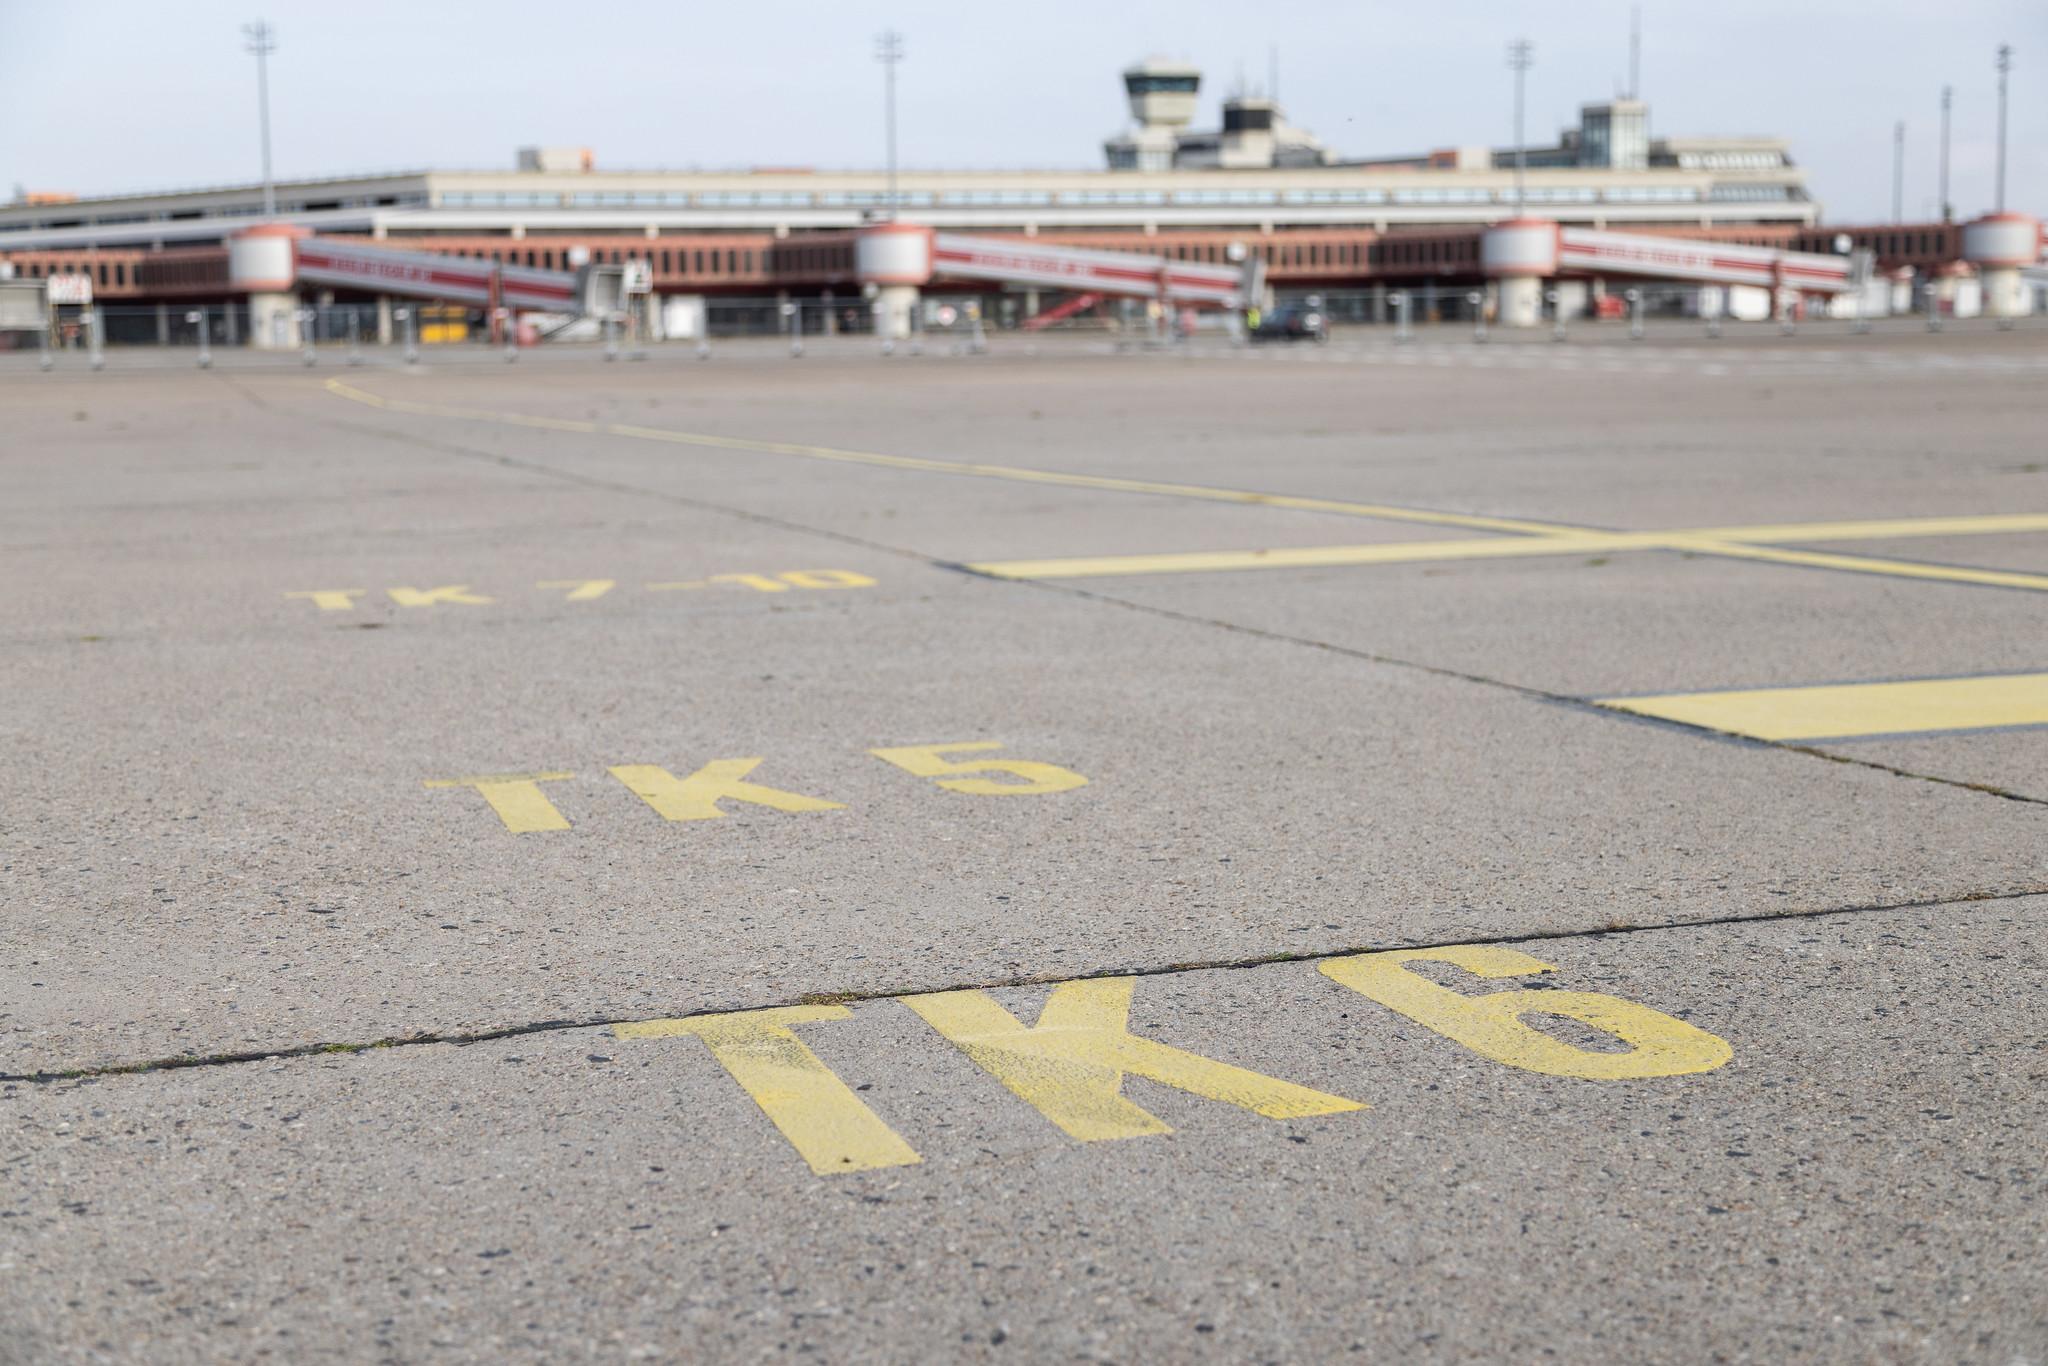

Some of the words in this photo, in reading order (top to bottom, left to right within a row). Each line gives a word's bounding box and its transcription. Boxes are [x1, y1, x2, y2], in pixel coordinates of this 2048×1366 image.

[284, 586, 498, 610] TK
[423, 756, 848, 833] TK
[870, 741, 1089, 795] 5
[612, 976, 1371, 1175] TK
[1317, 945, 1734, 1081] 6
